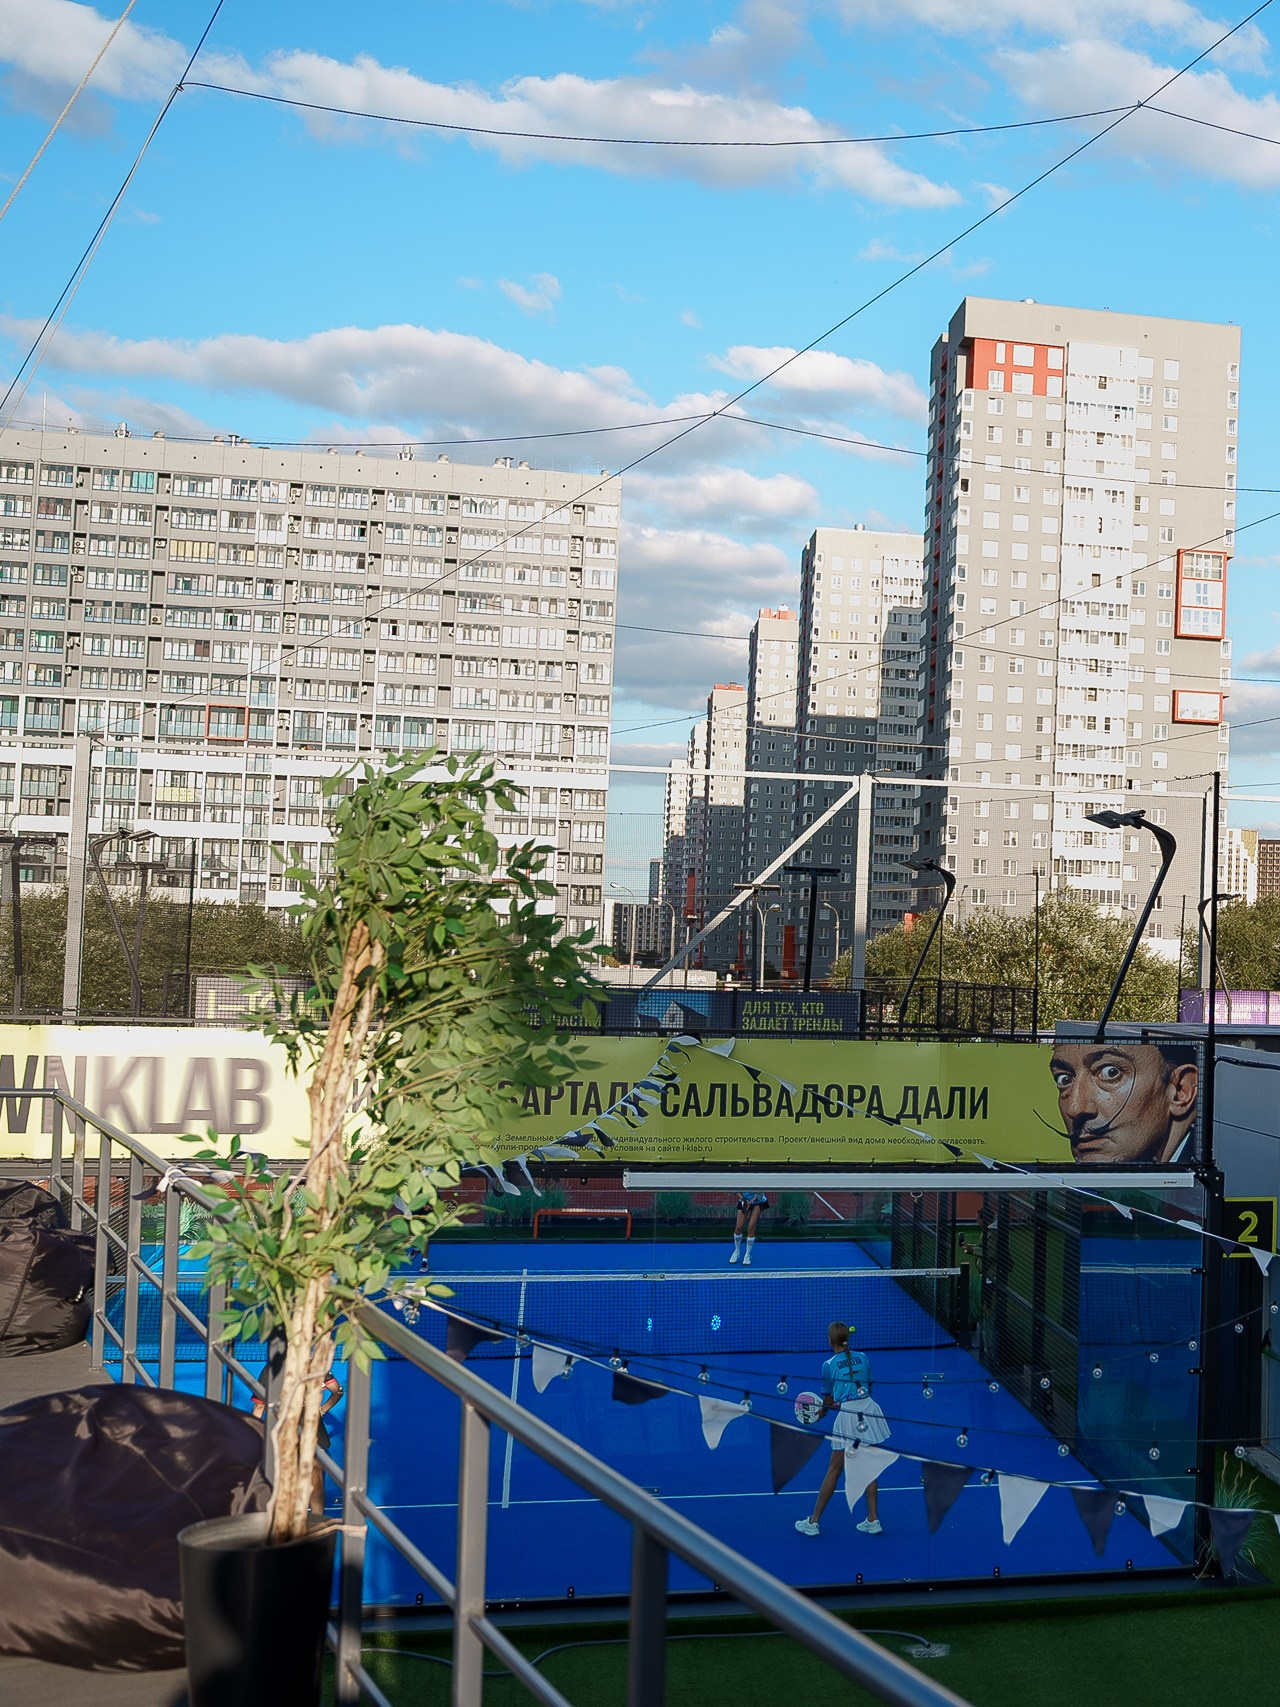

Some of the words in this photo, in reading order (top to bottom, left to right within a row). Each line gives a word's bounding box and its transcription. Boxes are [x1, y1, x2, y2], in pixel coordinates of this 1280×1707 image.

[742, 1001, 770, 1016] ДЛЯ
[774, 1001, 798, 1017] ТЕХ,
[801, 1002, 825, 1016] КТО
[791, 1017, 844, 1032] ТРЕНДЫ
[660, 1081, 886, 1124] САЛЬВАДОРА
[896, 1085, 988, 1125] ДАЛИ
[505, 1134, 554, 1142] Земельные
[714, 1136, 776, 1145] строительства.
[778, 1136, 846, 1145] Проект/внешний
[848, 1138, 863, 1146] вид
[864, 1138, 885, 1146] дома
[887, 1137, 935, 1146] необходимо
[610, 1145, 643, 1153] условия
[657, 1144, 681, 1153] сайте
[1238, 1210, 1258, 1243] 2
